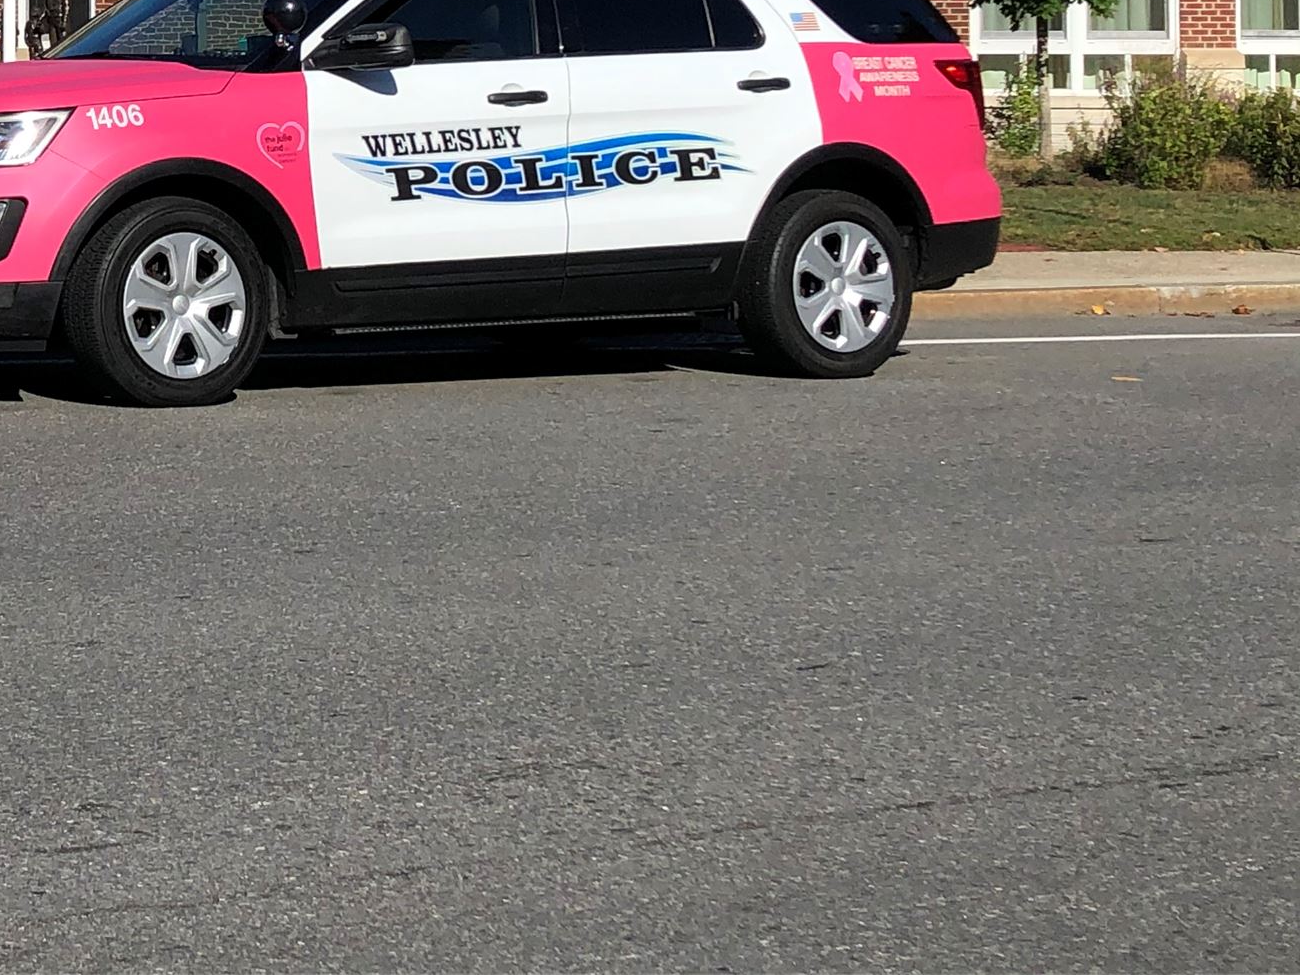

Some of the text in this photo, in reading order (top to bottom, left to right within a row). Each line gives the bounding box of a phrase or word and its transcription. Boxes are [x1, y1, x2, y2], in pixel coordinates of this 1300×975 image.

[851, 56, 918, 70] BREAST CANCER
[859, 71, 920, 82] AWARENESS
[873, 85, 912, 97] MONTH
[85, 104, 145, 130] 1406
[361, 125, 523, 158] WELLESLEY
[385, 147, 721, 202] POLICE
